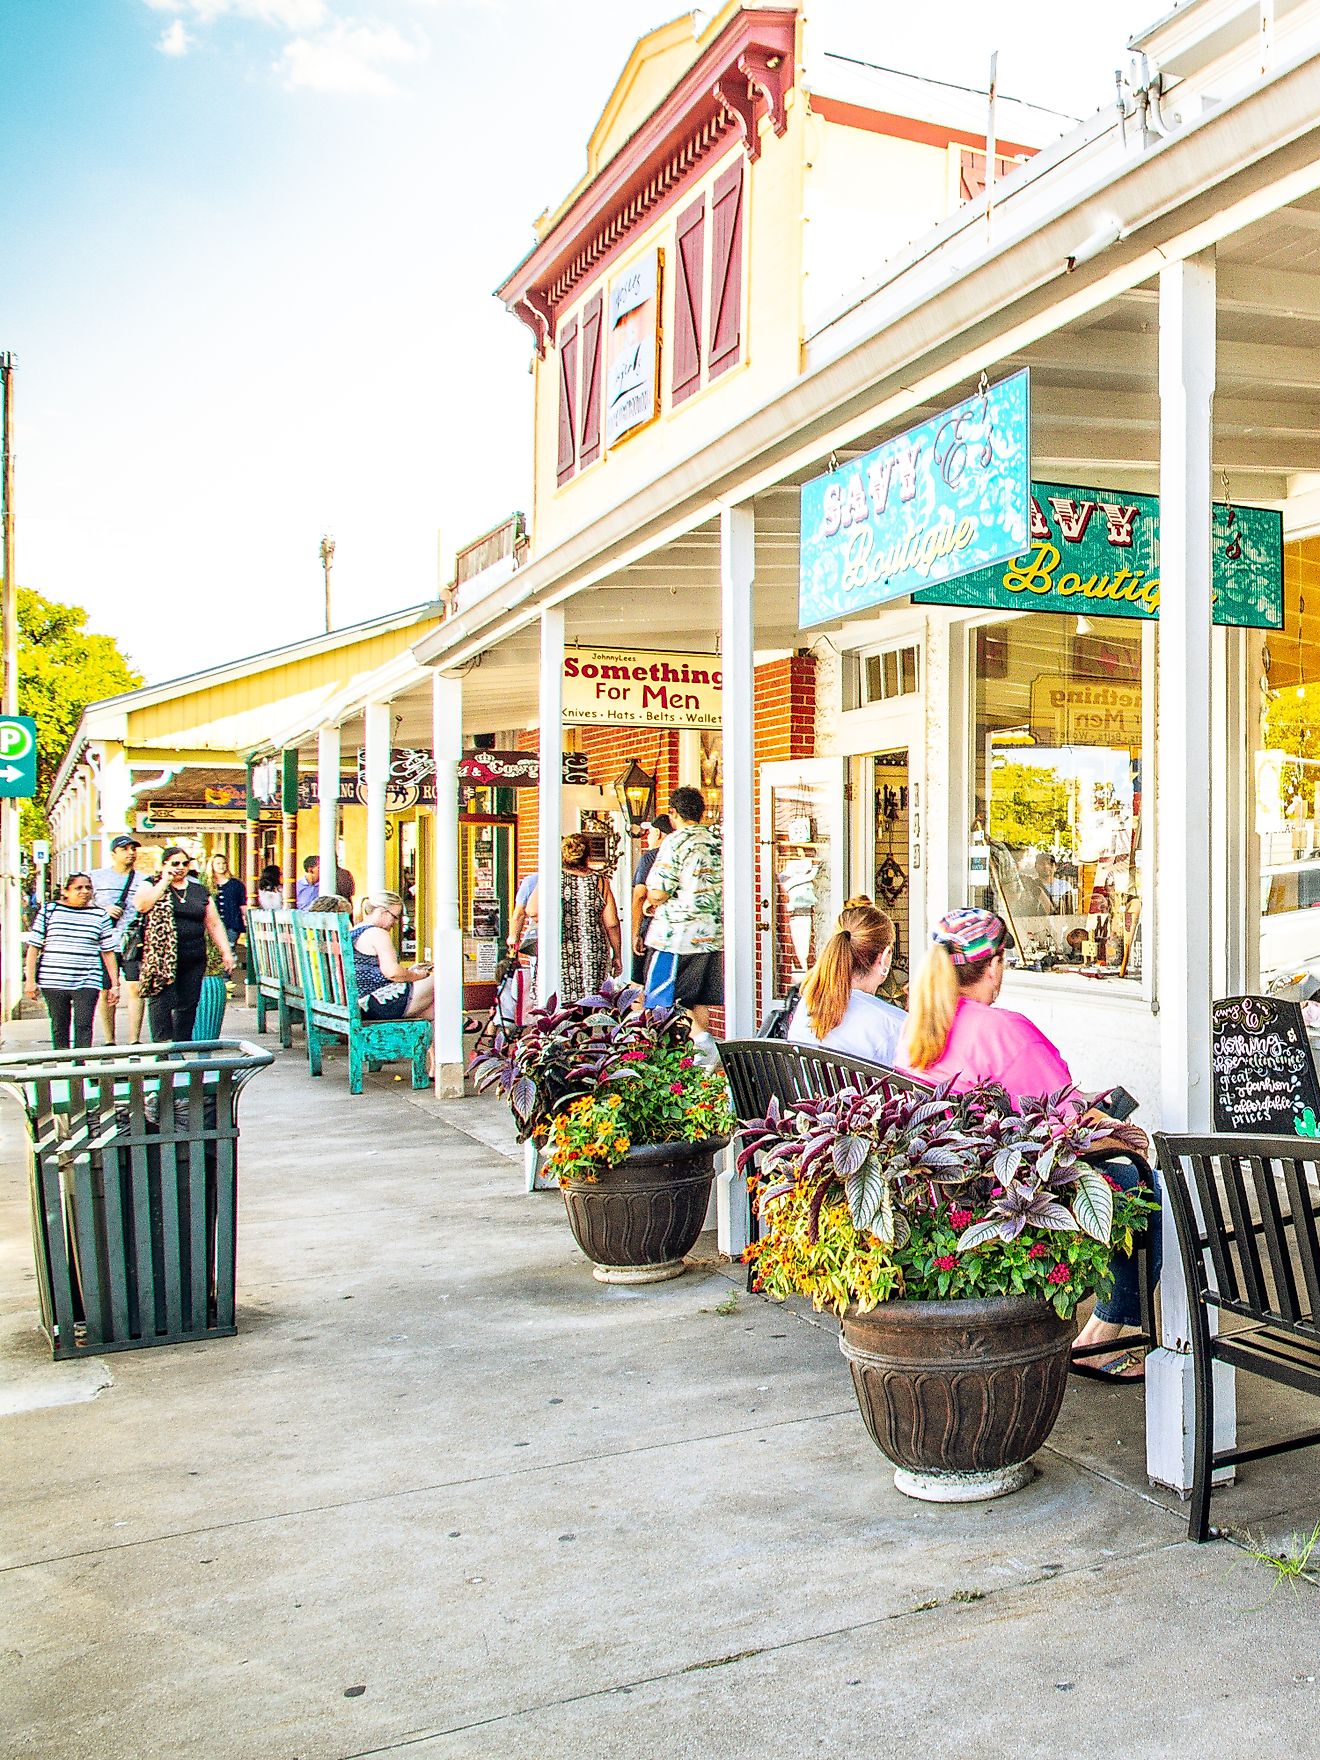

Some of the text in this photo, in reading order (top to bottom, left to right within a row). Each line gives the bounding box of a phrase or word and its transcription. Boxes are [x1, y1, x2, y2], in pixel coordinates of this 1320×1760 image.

[823, 446, 922, 538] SAVY
[1031, 496, 1142, 547] VY
[841, 517, 976, 593] Boutique
[596, 683, 700, 709] For Men
[607, 710, 636, 720] Hats
[646, 711, 675, 722] Belts
[685, 712, 723, 723] Wallet
[1231, 1110, 1272, 1129] prices
